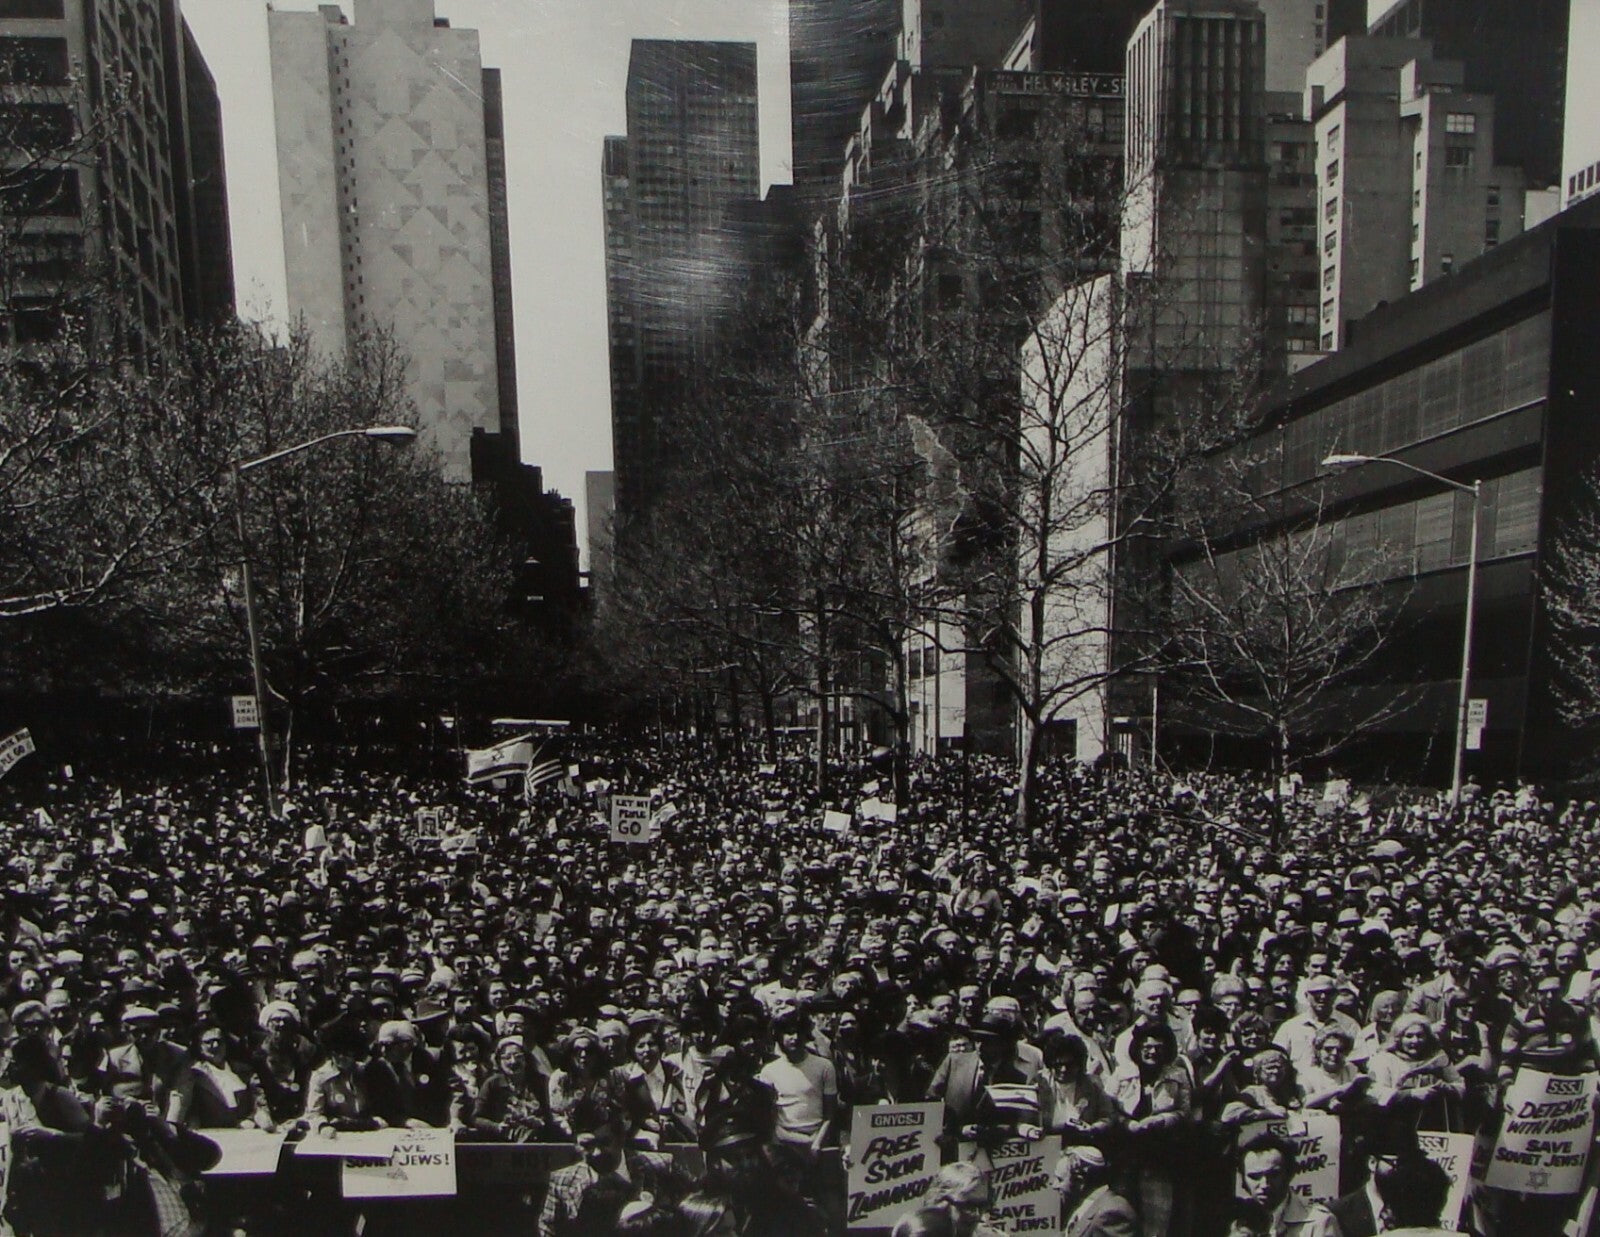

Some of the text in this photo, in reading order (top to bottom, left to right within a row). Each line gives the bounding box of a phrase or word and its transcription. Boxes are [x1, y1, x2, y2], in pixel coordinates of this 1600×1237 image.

[616, 799, 649, 808] LET MY
[619, 809, 646, 819] PEOPLE
[618, 820, 641, 836] GO
[1518, 1093, 1589, 1119] DETENTE
[1506, 1120, 1547, 1135] WITH
[393, 1144, 426, 1153] AVE
[861, 1130, 922, 1165] FREE
[1525, 1139, 1573, 1153] SAVE
[399, 1153, 450, 1166] JEWS!
[1495, 1147, 1586, 1167] SOVIET JEWS!
[989, 1204, 1035, 1221] SAVE
[1010, 1216, 1056, 1233] JEWS!
